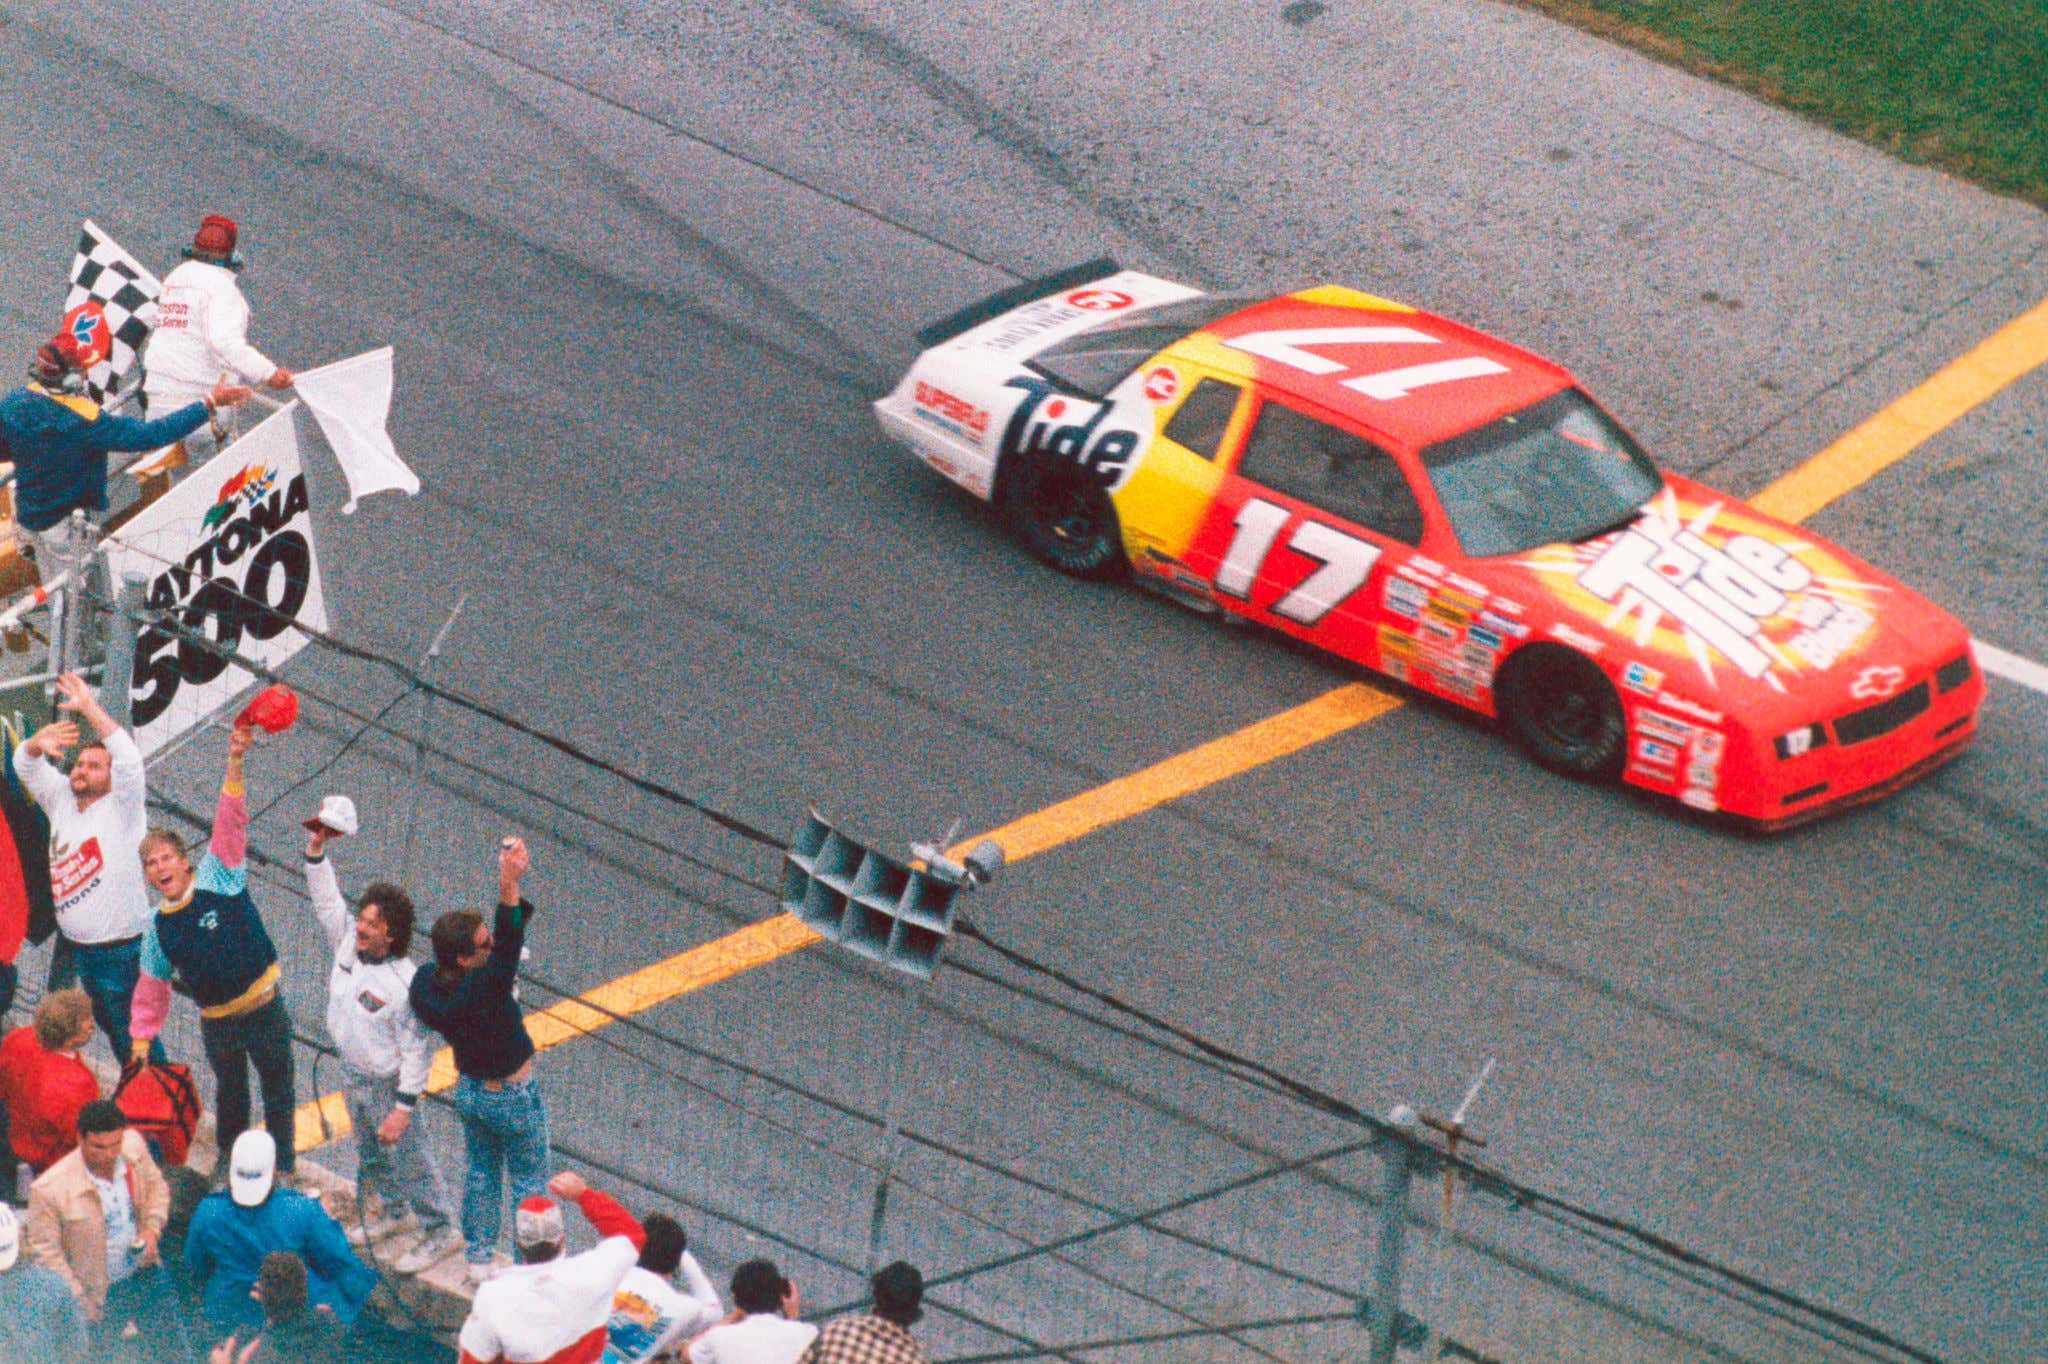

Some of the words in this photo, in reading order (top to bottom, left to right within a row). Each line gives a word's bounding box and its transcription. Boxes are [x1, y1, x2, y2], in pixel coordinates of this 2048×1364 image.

[1002, 374, 1140, 488] Tide
[144, 472, 309, 611] AYTONA
[1214, 496, 1383, 627] 17
[1577, 528, 1813, 678] Tide
[130, 529, 311, 728] 500
